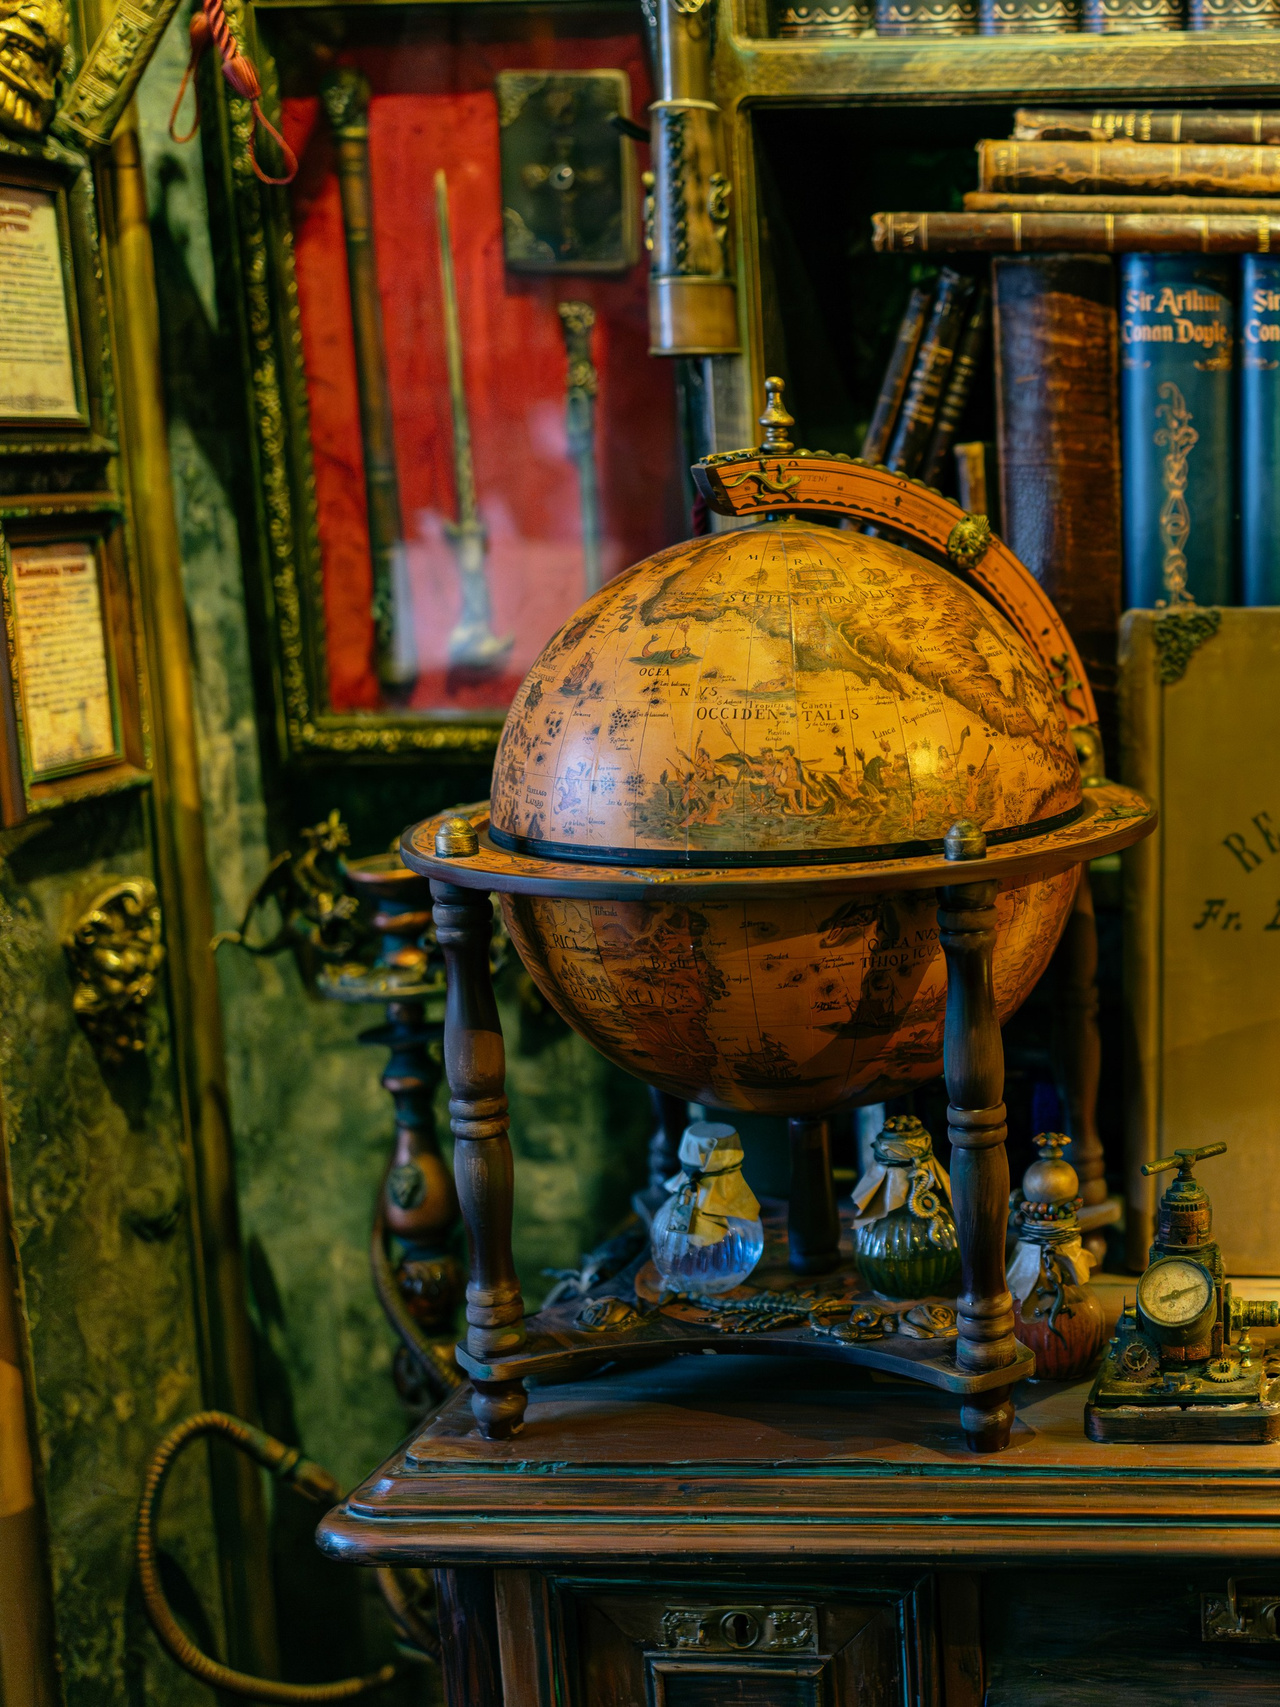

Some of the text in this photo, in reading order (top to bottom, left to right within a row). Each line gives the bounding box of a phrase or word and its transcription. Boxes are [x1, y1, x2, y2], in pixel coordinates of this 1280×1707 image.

[1125, 288, 1152, 314] Sir
[1252, 287, 1279, 313] Sir
[1122, 319, 1174, 344] Conan
